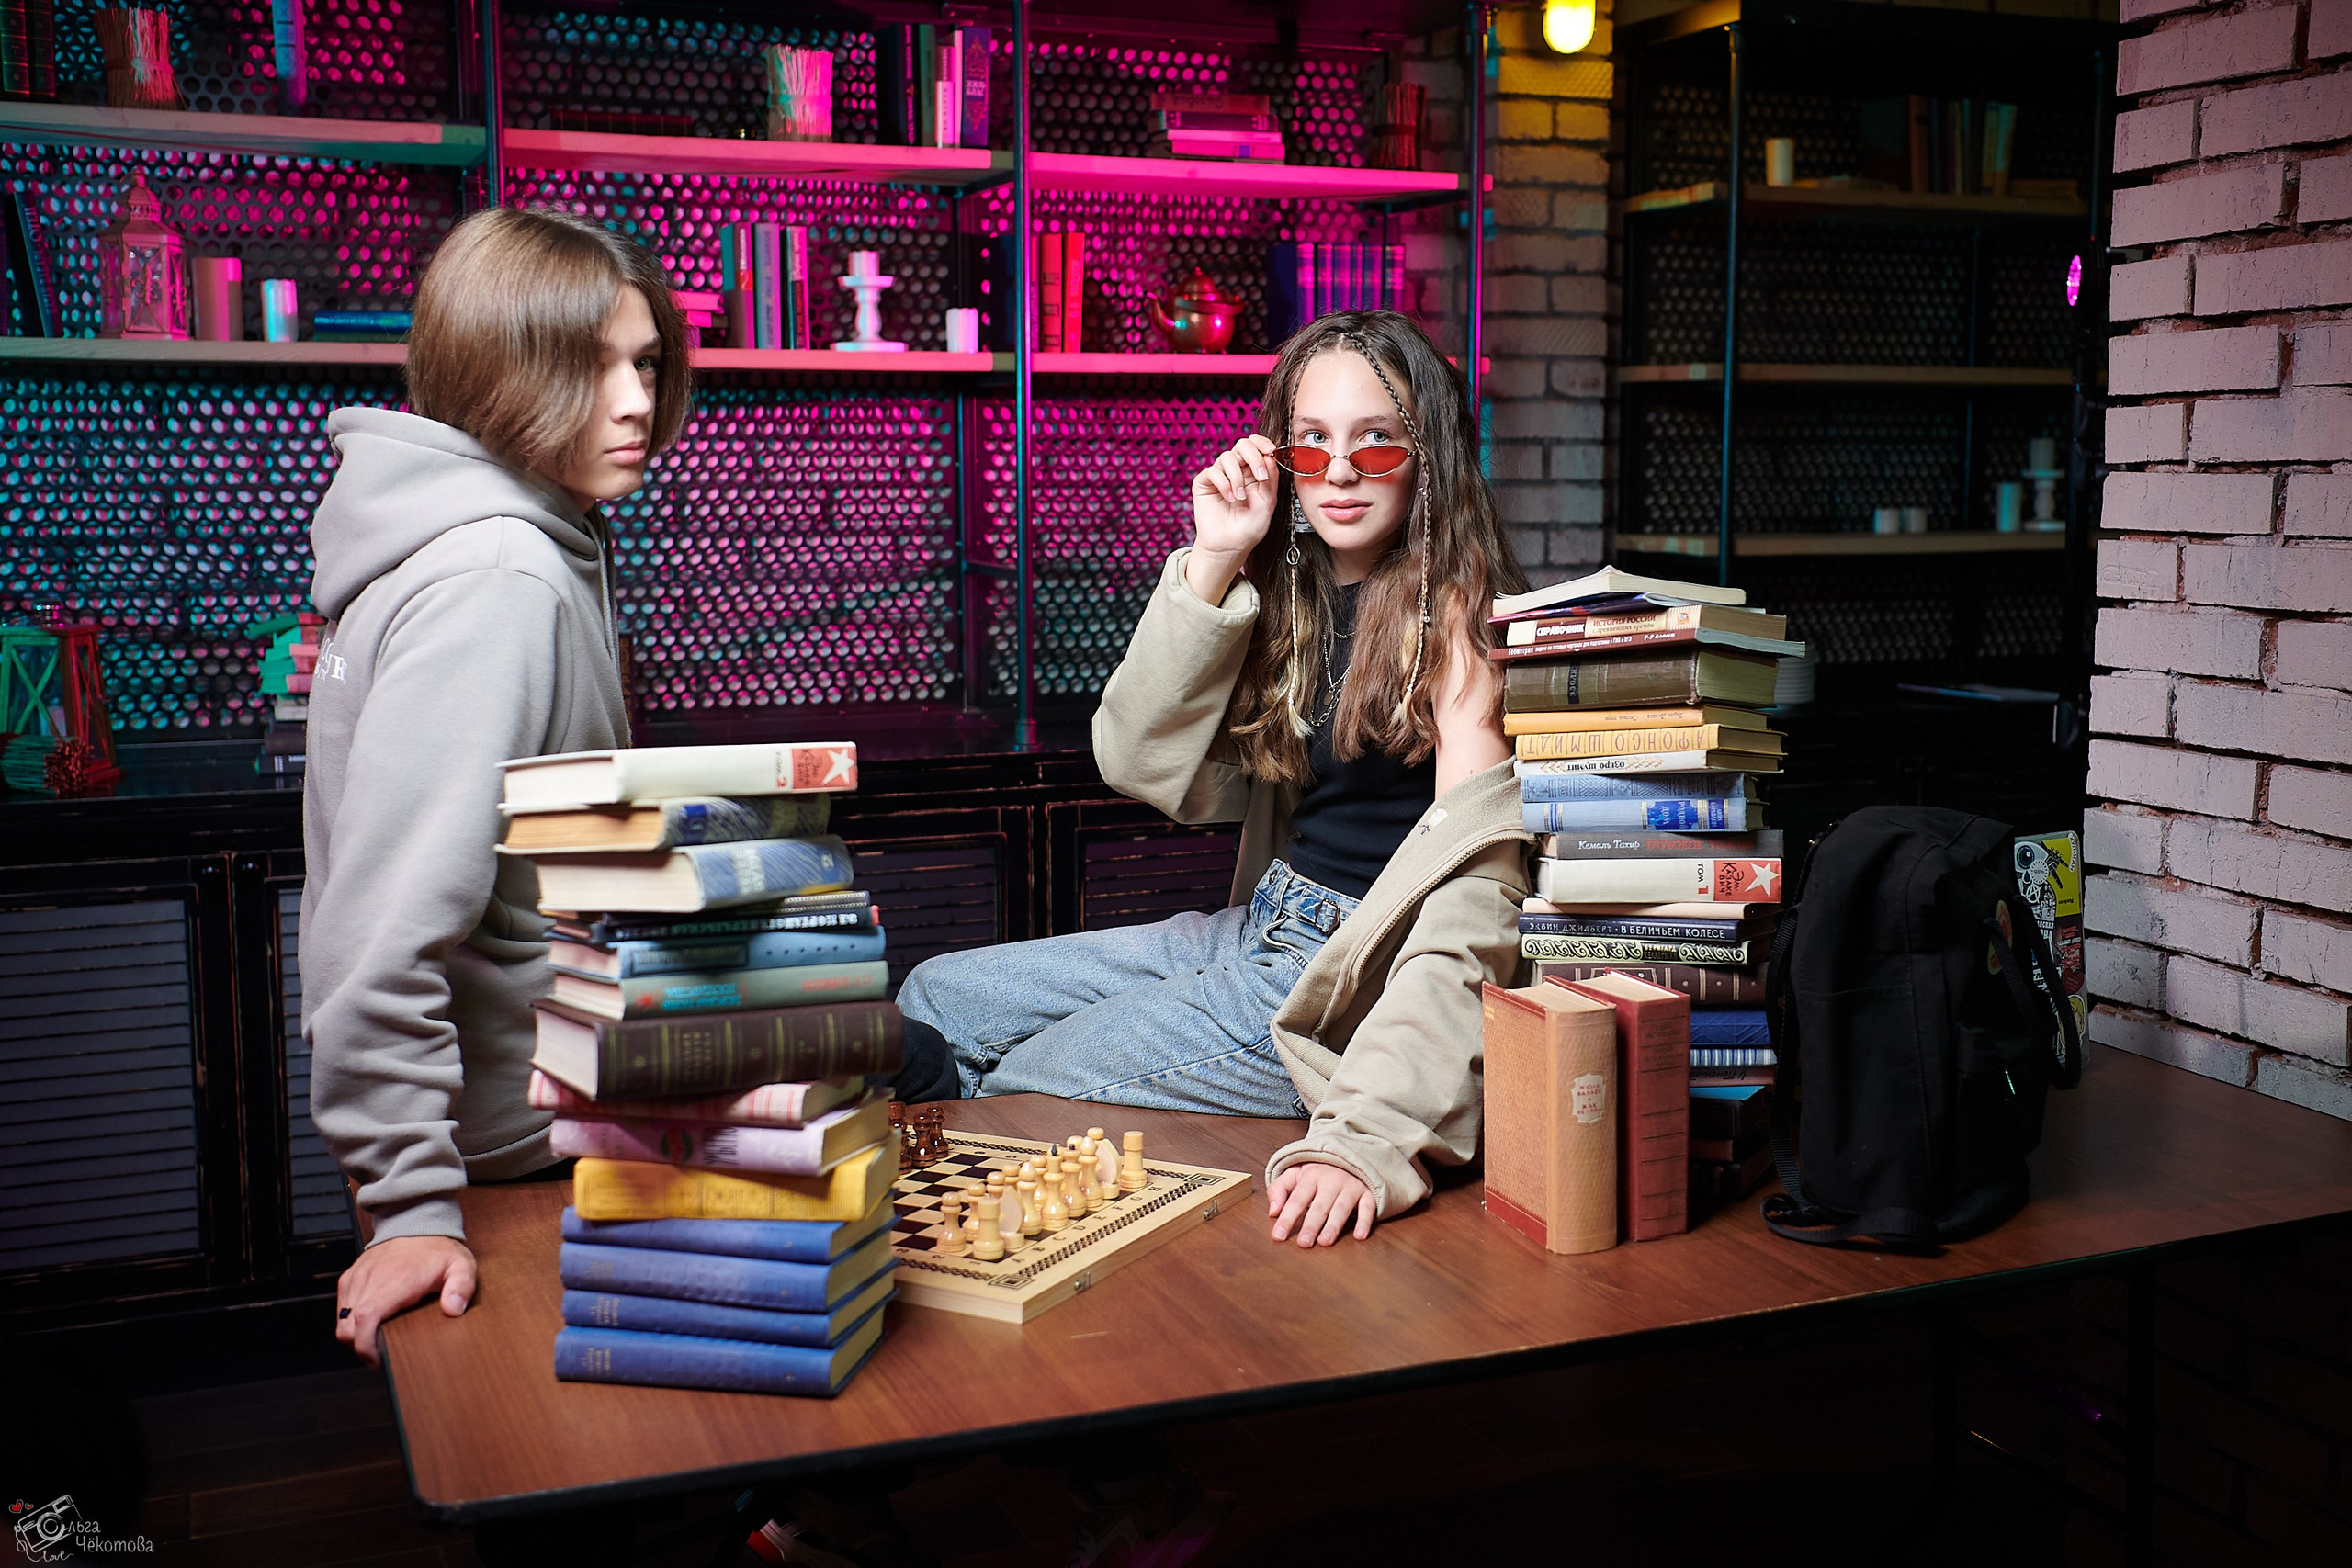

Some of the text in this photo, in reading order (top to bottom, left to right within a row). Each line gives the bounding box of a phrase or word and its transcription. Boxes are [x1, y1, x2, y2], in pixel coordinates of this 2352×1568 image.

[1593, 615, 1656, 626] ИСТОРИЯ РОССИИ
[1536, 622, 1585, 636] СПРАВОЧНИК
[1508, 647, 1534, 656] Геометрия
[1526, 731, 1704, 754] АФОНСО ШМИДТ
[1566, 762, 1597, 772] шумит
[1660, 806, 1670, 825] ДОМ
[1677, 801, 1688, 829] РОДНОЙ
[1577, 840, 1641, 851] Кемаль Тахир
[1529, 922, 1559, 931] ЭДВИН
[1562, 924, 1612, 933] ДЖИЛБЕРТ
[1629, 926, 1680, 936] БЕЛИЧЬЕМ
[1685, 929, 1725, 939] КОЛЕСЕ
